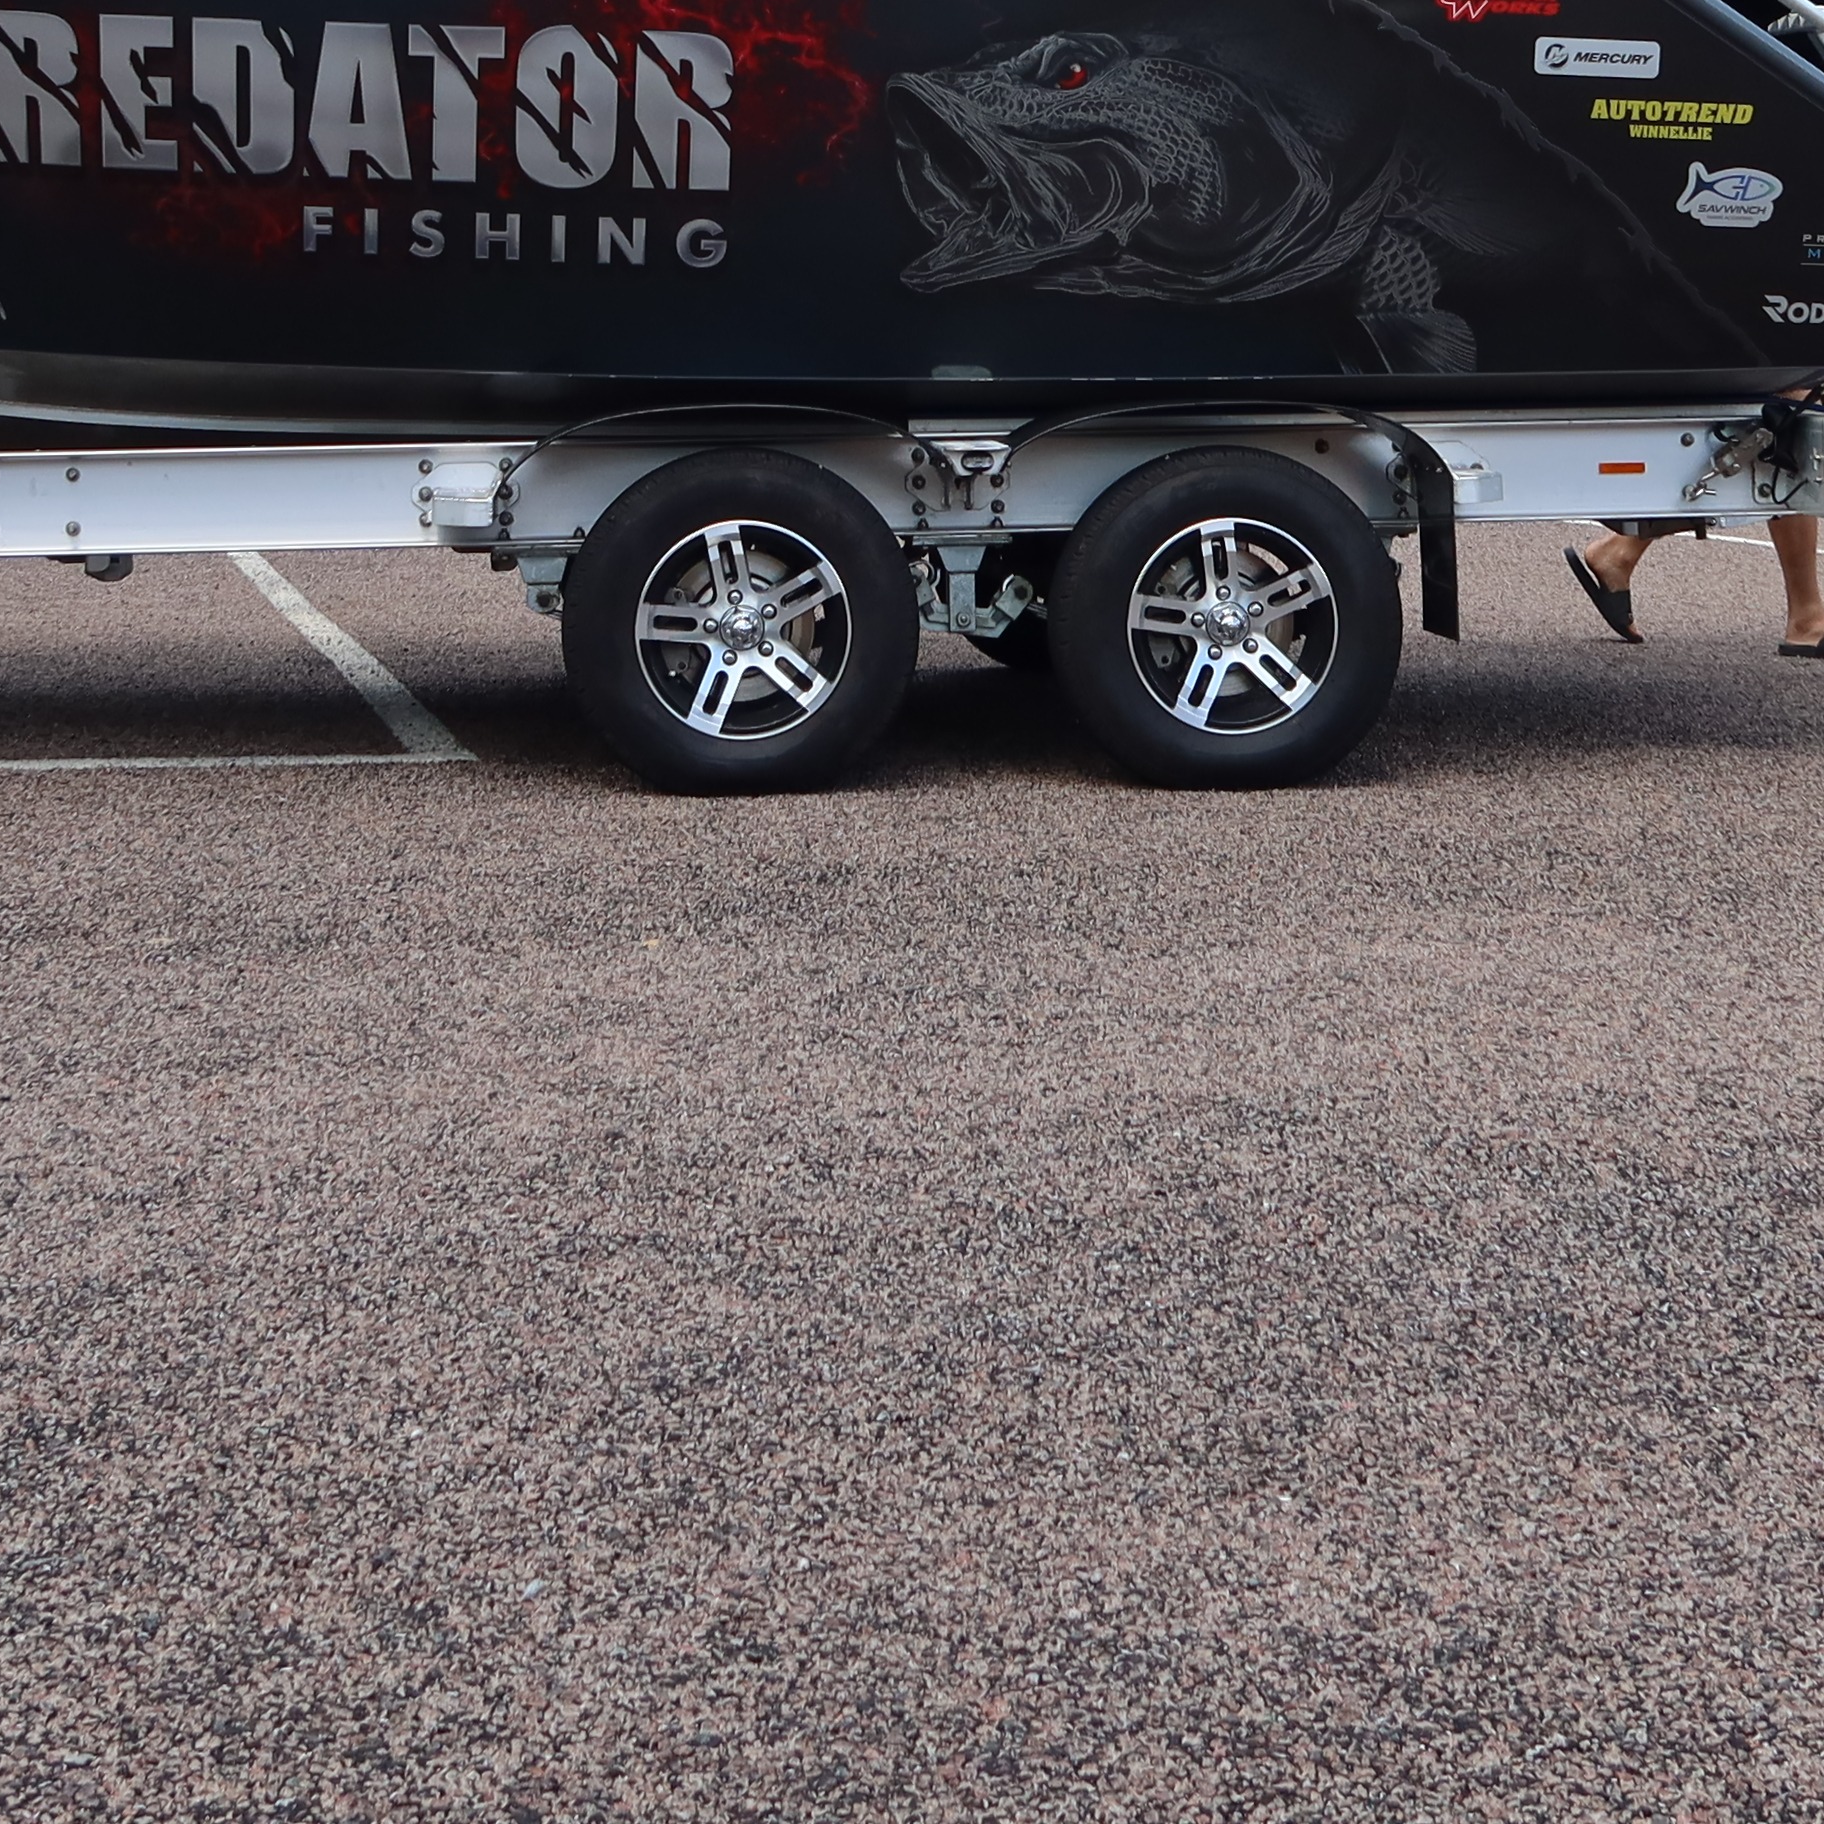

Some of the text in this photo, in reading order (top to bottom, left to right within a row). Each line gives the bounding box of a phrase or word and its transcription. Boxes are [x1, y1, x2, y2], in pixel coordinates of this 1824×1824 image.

[1573, 52, 1654, 66] MERCURY
[1590, 98, 1754, 125] AUTOTREND
[1629, 124, 1713, 141] WINNELLIE
[1697, 204, 1768, 215] SAVWINCH
[303, 205, 728, 269] FISHING
